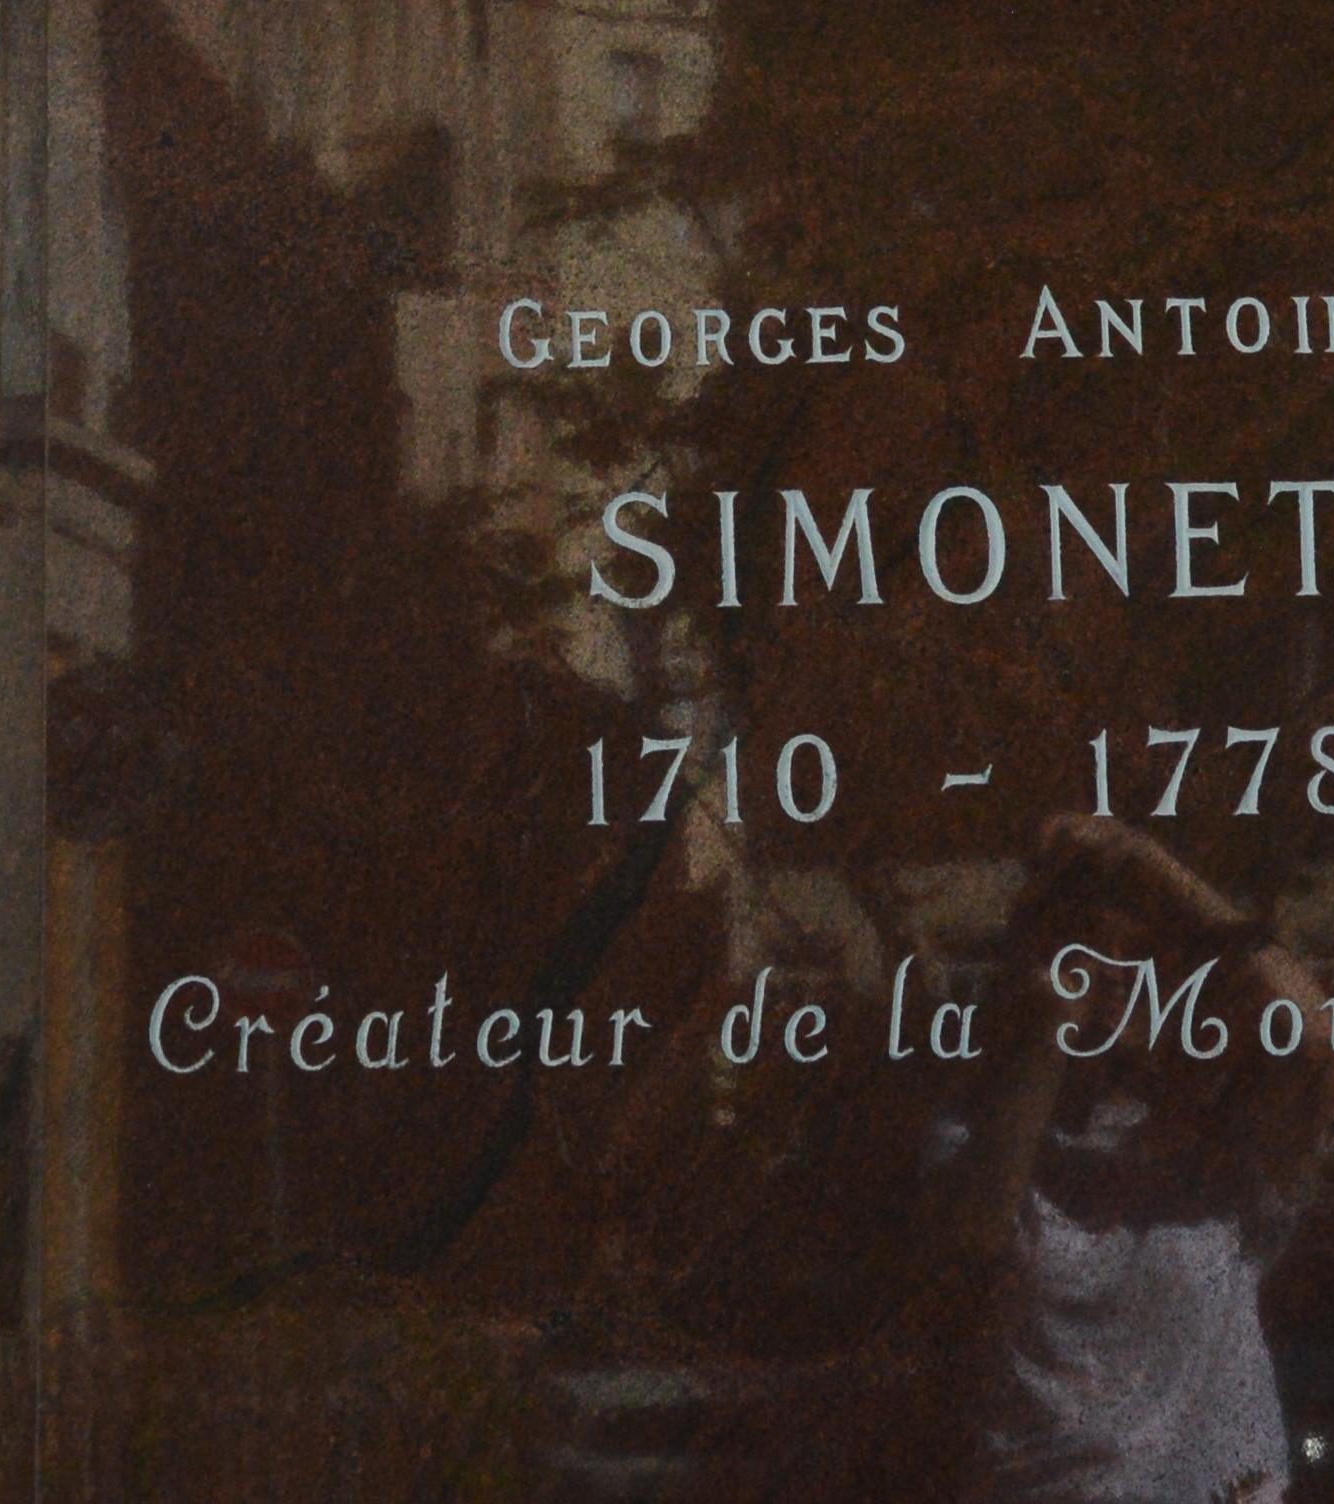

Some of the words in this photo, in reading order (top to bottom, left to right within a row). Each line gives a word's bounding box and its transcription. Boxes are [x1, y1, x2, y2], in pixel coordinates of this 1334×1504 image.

[586, 732, 840, 826] 1710
[147, 972, 653, 1074] Créateur
[719, 966, 830, 1065] de
[887, 954, 983, 1060] la
